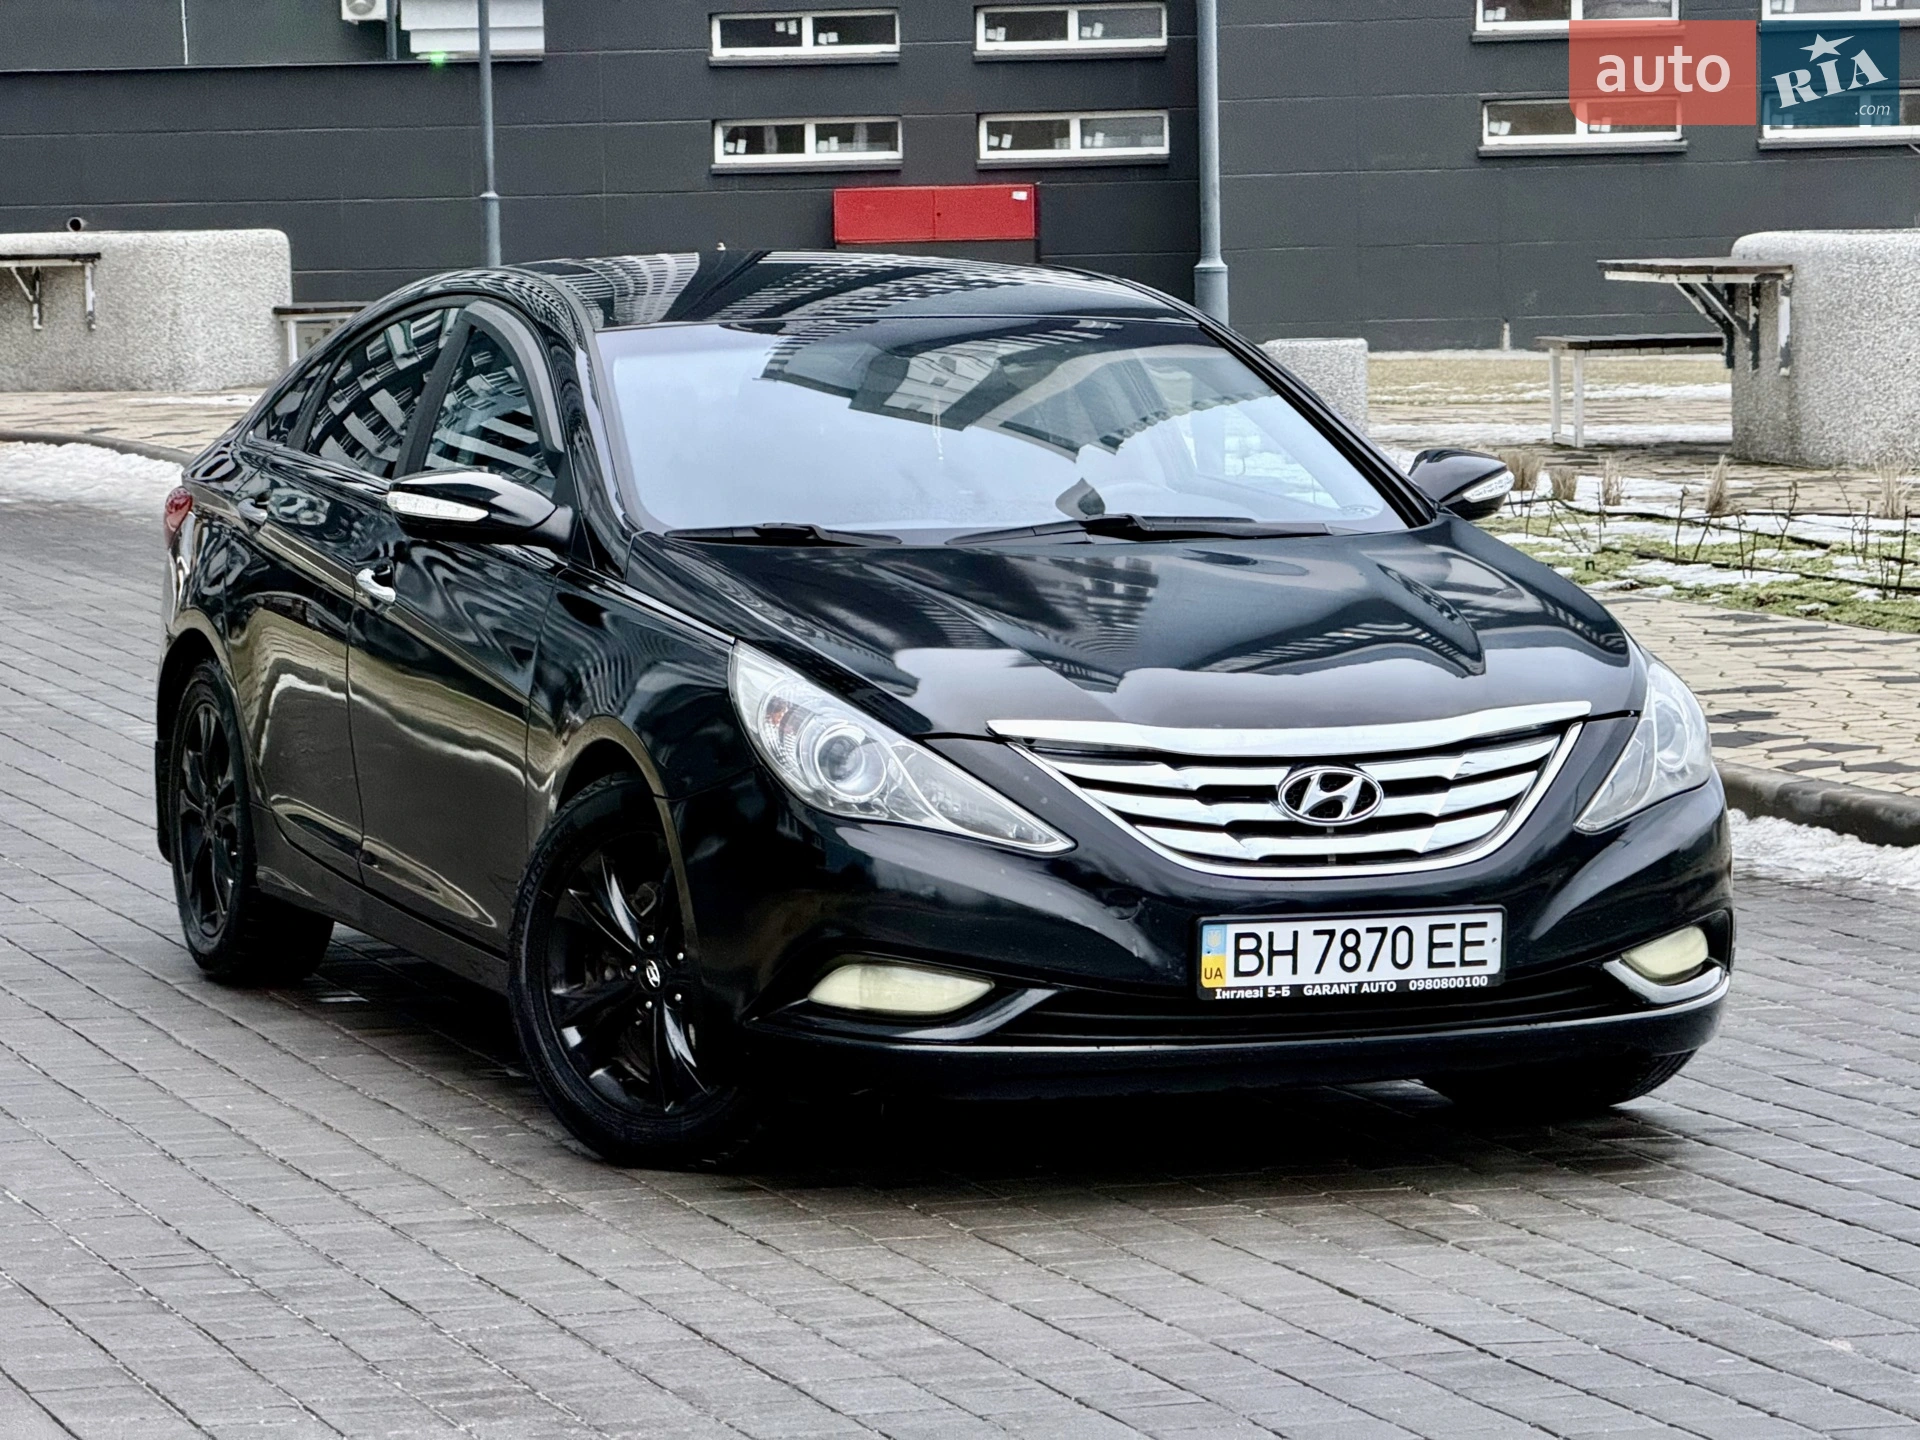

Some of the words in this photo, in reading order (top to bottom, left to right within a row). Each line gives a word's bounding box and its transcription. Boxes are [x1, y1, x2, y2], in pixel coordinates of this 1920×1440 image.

[1233, 930, 1298, 977] BH
[1312, 925, 1414, 974] 7870
[1427, 921, 1488, 969] EE
[1203, 967, 1223, 980] UA
[1303, 983, 1358, 996] GARANT
[1361, 981, 1397, 993] AUTO
[1409, 976, 1488, 990] 0980800100
